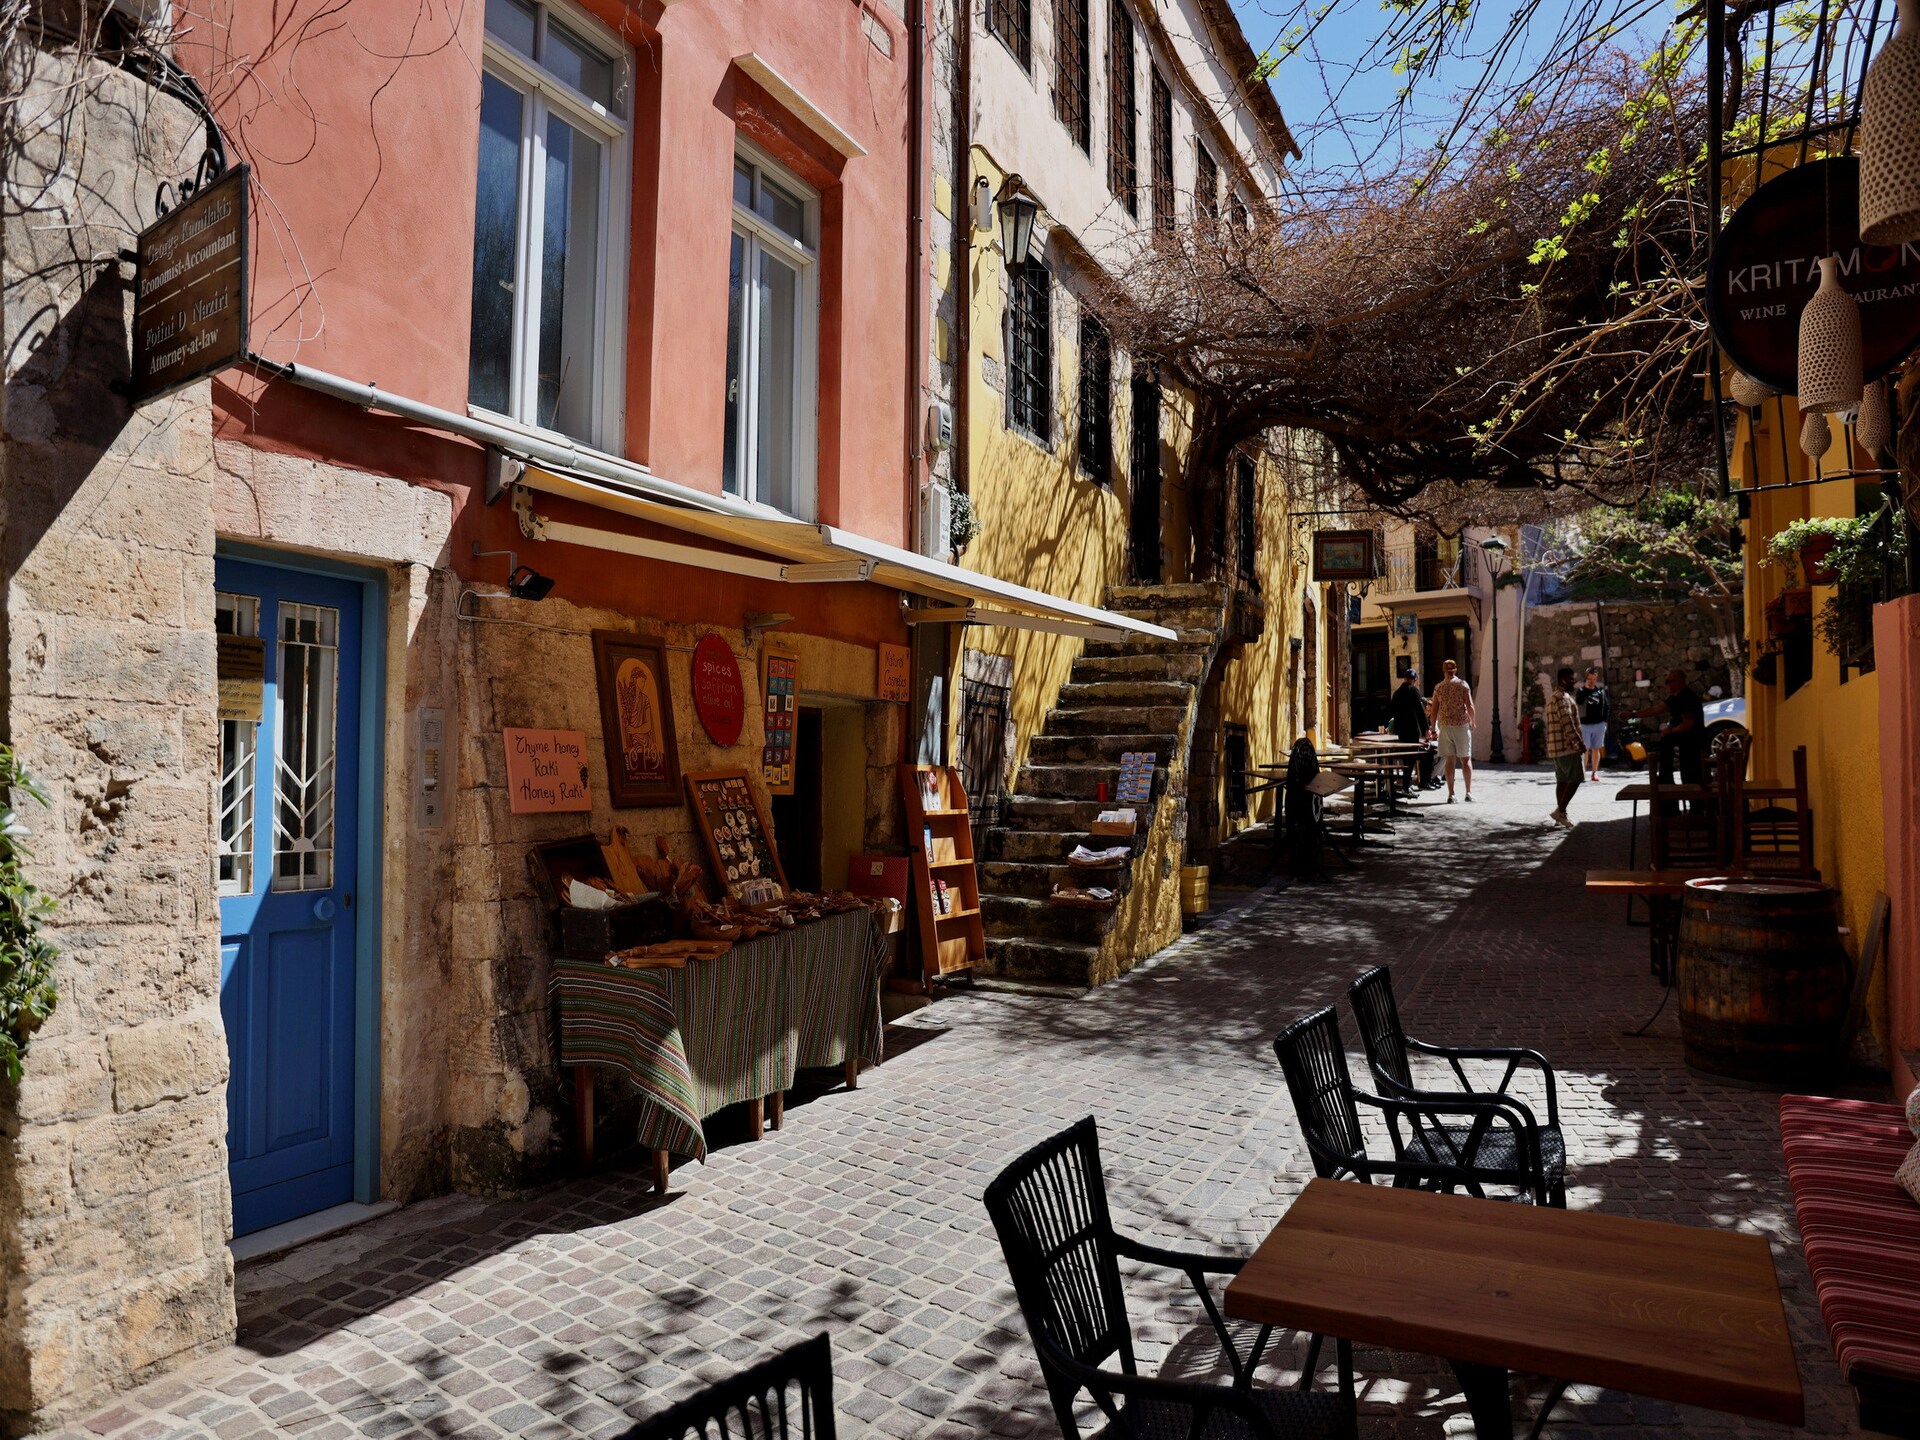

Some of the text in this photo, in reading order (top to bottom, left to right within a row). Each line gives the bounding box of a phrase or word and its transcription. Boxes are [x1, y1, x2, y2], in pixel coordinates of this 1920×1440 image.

[147, 234, 179, 266] George
[140, 227, 237, 299] Economist-Accountant
[1739, 303, 1788, 321] WINE
[149, 328, 219, 375] Attorney-at-law
[702, 661, 732, 677] spices
[514, 734, 579, 758] Thyme honey
[531, 757, 559, 777] Raki
[520, 778, 584, 805] Honey Raki
